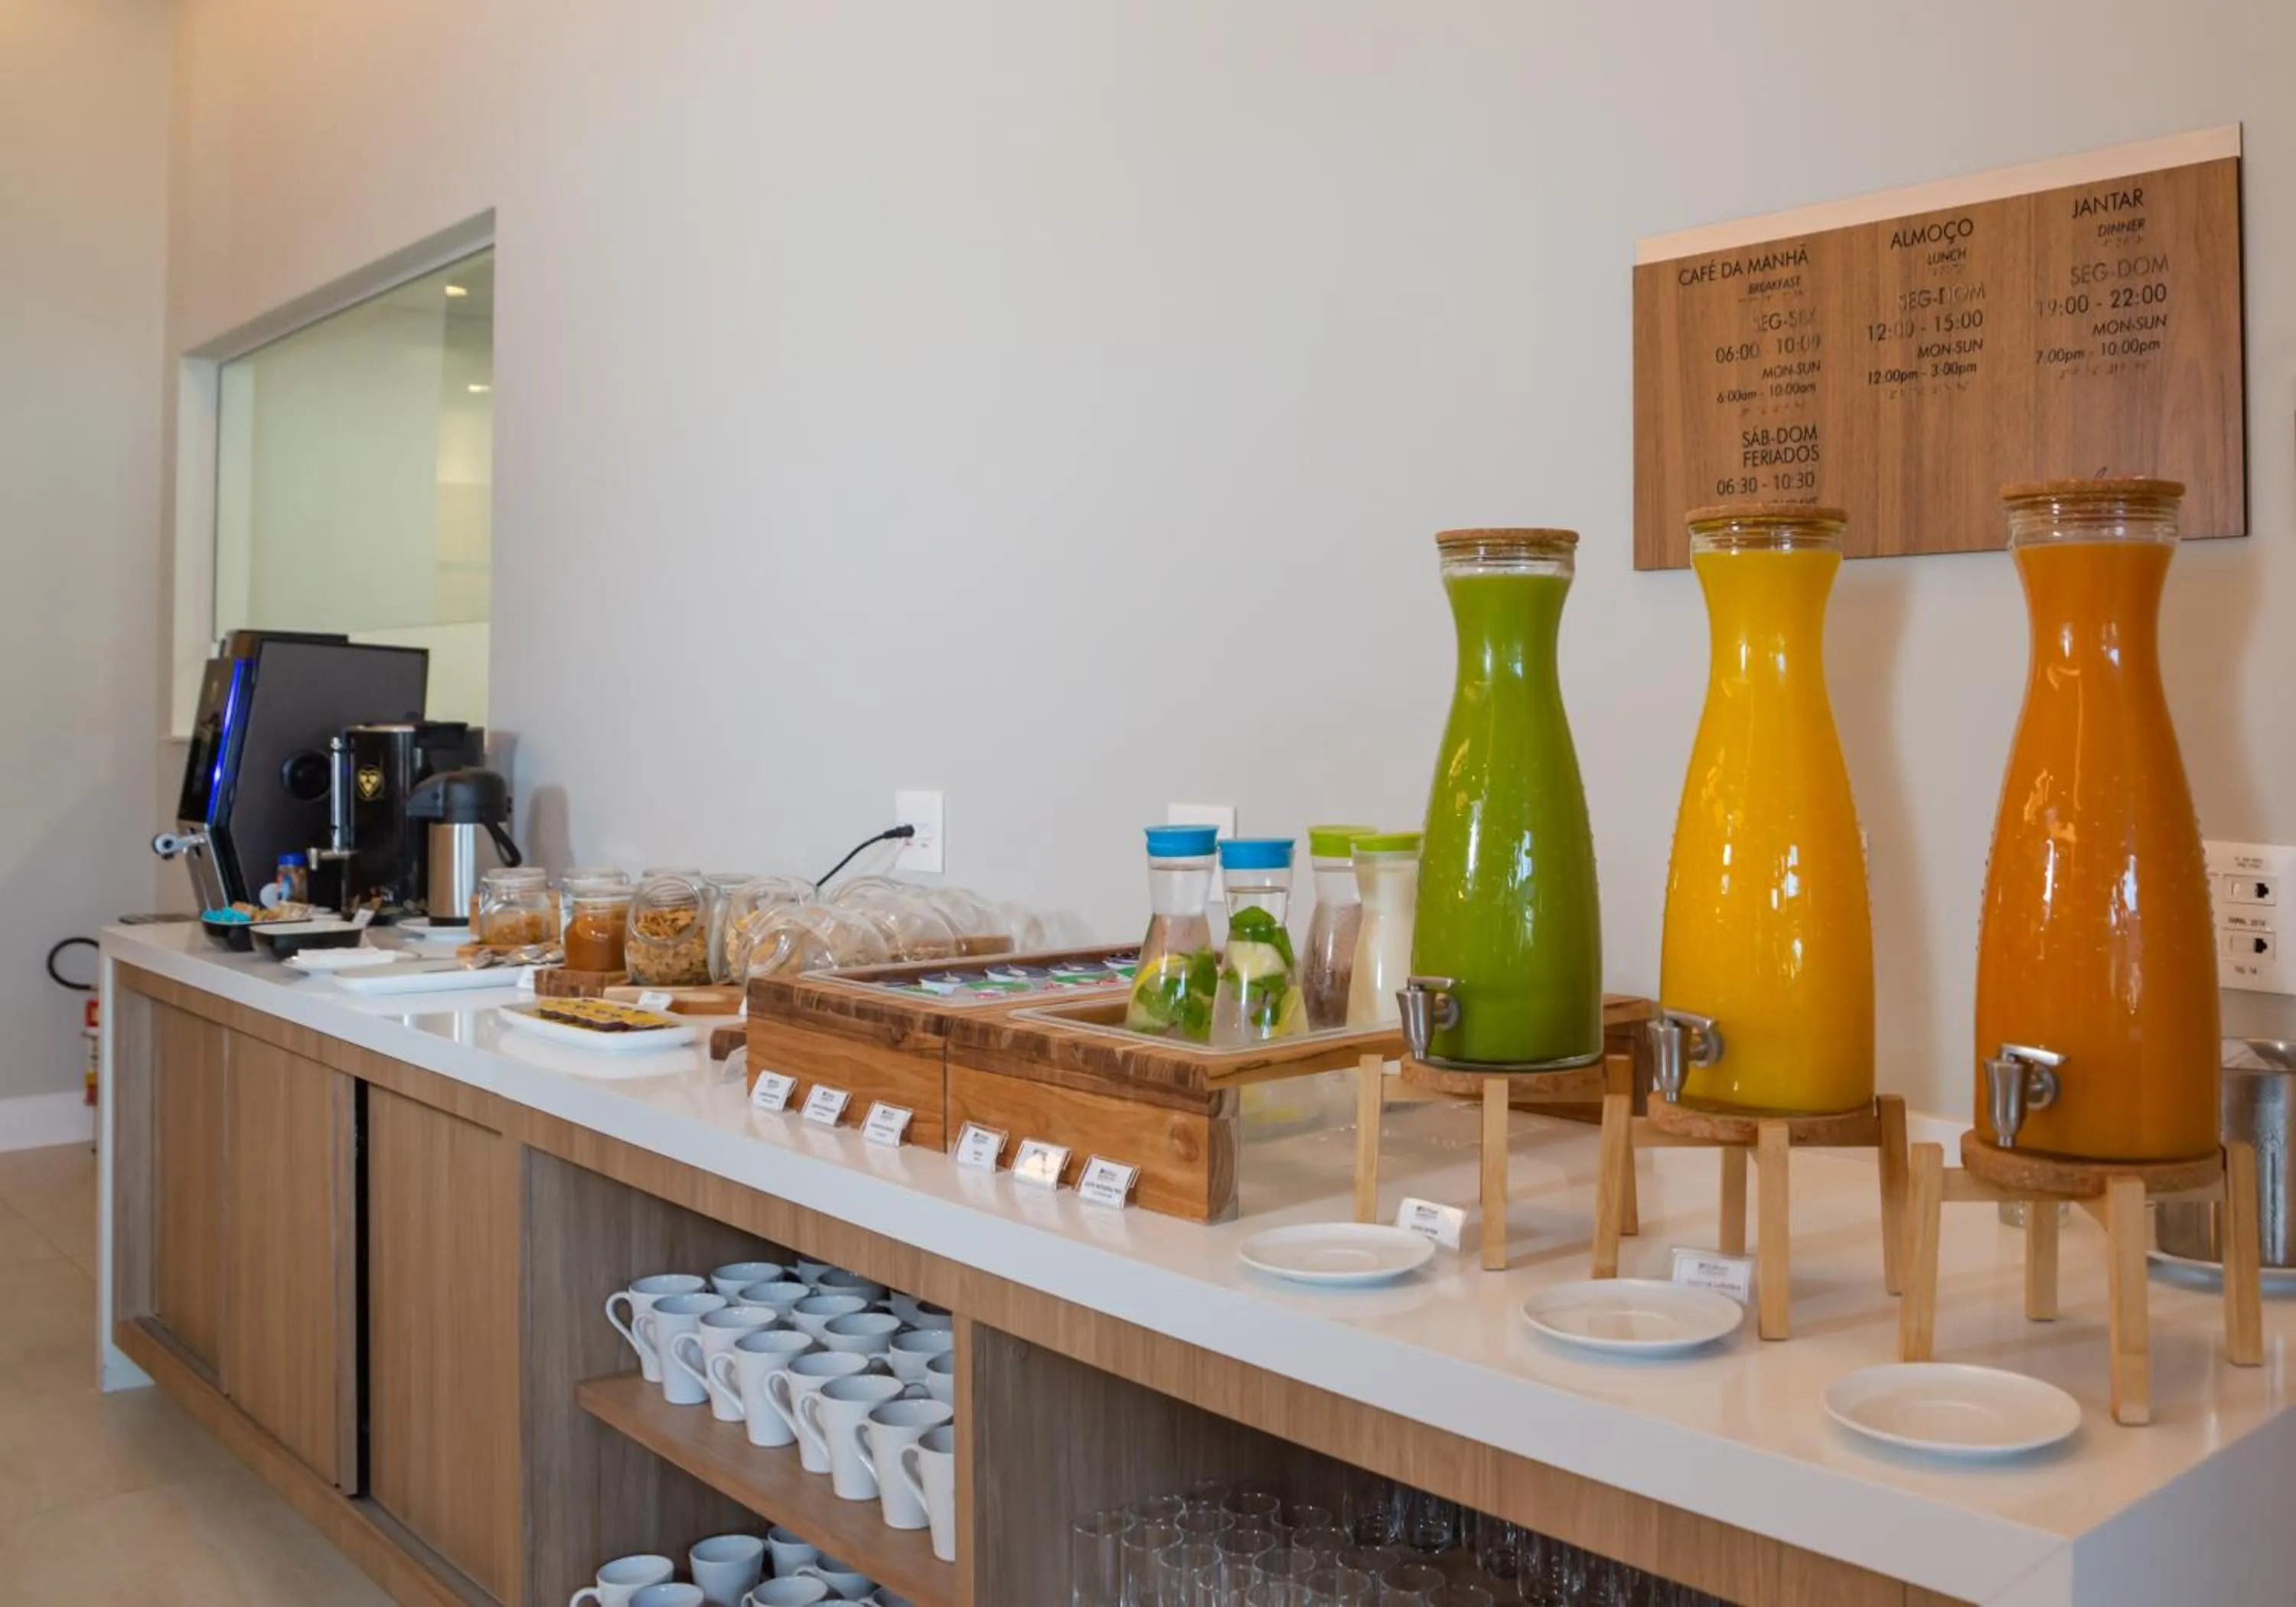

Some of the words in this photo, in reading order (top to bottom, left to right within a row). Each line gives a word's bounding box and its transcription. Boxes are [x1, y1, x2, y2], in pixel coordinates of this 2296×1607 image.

[2072, 188, 2144, 219] JANTAR
[1890, 218, 1975, 249] ALMOÇO
[2098, 218, 2145, 237] DINNER
[1678, 259, 1715, 286] CAFÉ
[1720, 261, 1743, 279] DA
[1747, 244, 1809, 275] MANHÃ
[1928, 247, 1967, 266] LUNCH
[2070, 253, 2170, 286] SEG-DOM
[1749, 275, 1801, 295] BREAKFAST
[2110, 283, 2167, 308] 22:00
[1935, 309, 1984, 332] 15:00
[2092, 314, 2167, 337] MON-SUN
[1715, 341, 1760, 364] 06:00
[1917, 338, 1984, 360] MON-SUN
[1763, 360, 1821, 380] MON-SUN
[1931, 362, 1977, 378] 3:00pm
[1742, 422, 1818, 449] SÁB-DOM
[1743, 444, 1820, 469] FERIADOS
[1717, 476, 1759, 497] 06:30
[1773, 471, 1815, 491] 10:30
